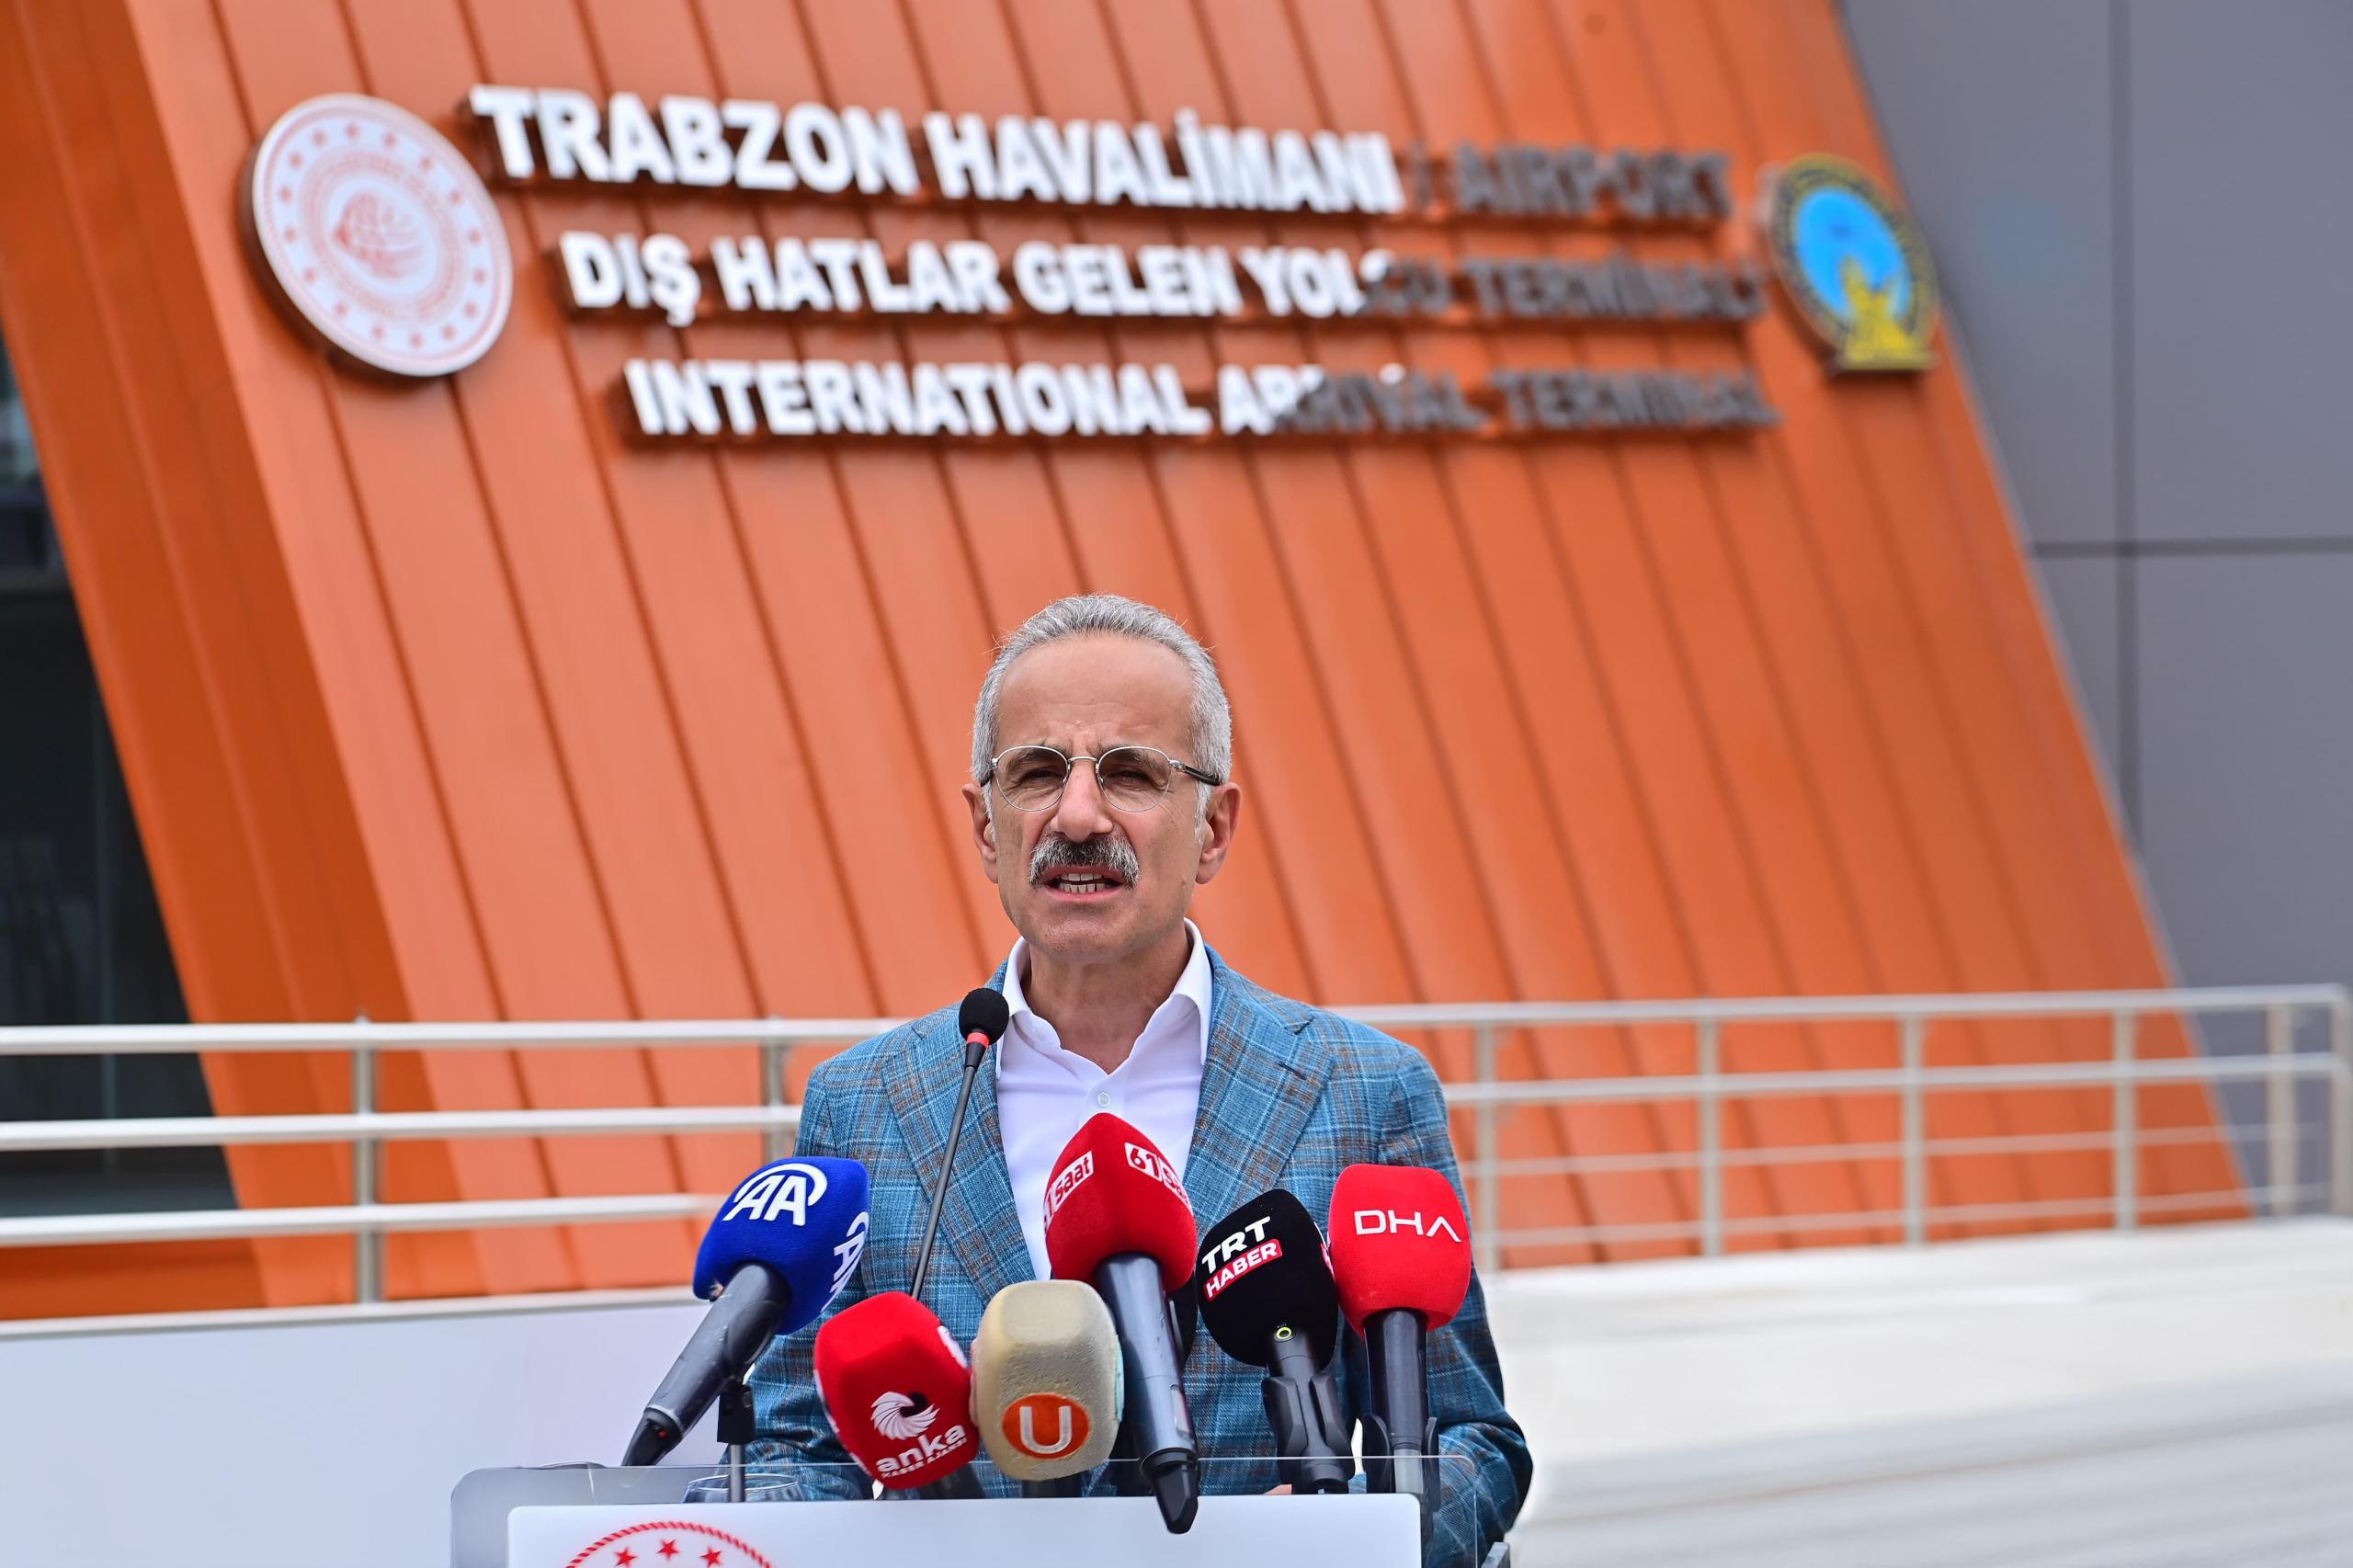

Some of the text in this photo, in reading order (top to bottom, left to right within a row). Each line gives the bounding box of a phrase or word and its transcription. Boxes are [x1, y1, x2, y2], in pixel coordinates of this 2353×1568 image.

[469, 85, 918, 195] TRABZON
[922, 108, 1405, 213] HAVALİMANI
[560, 231, 701, 326] DIŞ
[710, 235, 1012, 313] HATLAR
[1013, 241, 1244, 316] GELEN
[623, 358, 1212, 437] INTERNATIONAL
[722, 1174, 808, 1227] AA
[1354, 1209, 1462, 1243] DHA
[1201, 1216, 1271, 1274] TRT
[1206, 1242, 1278, 1299] HABER
[875, 1425, 965, 1472] anka
[1019, 1405, 1073, 1454] U
